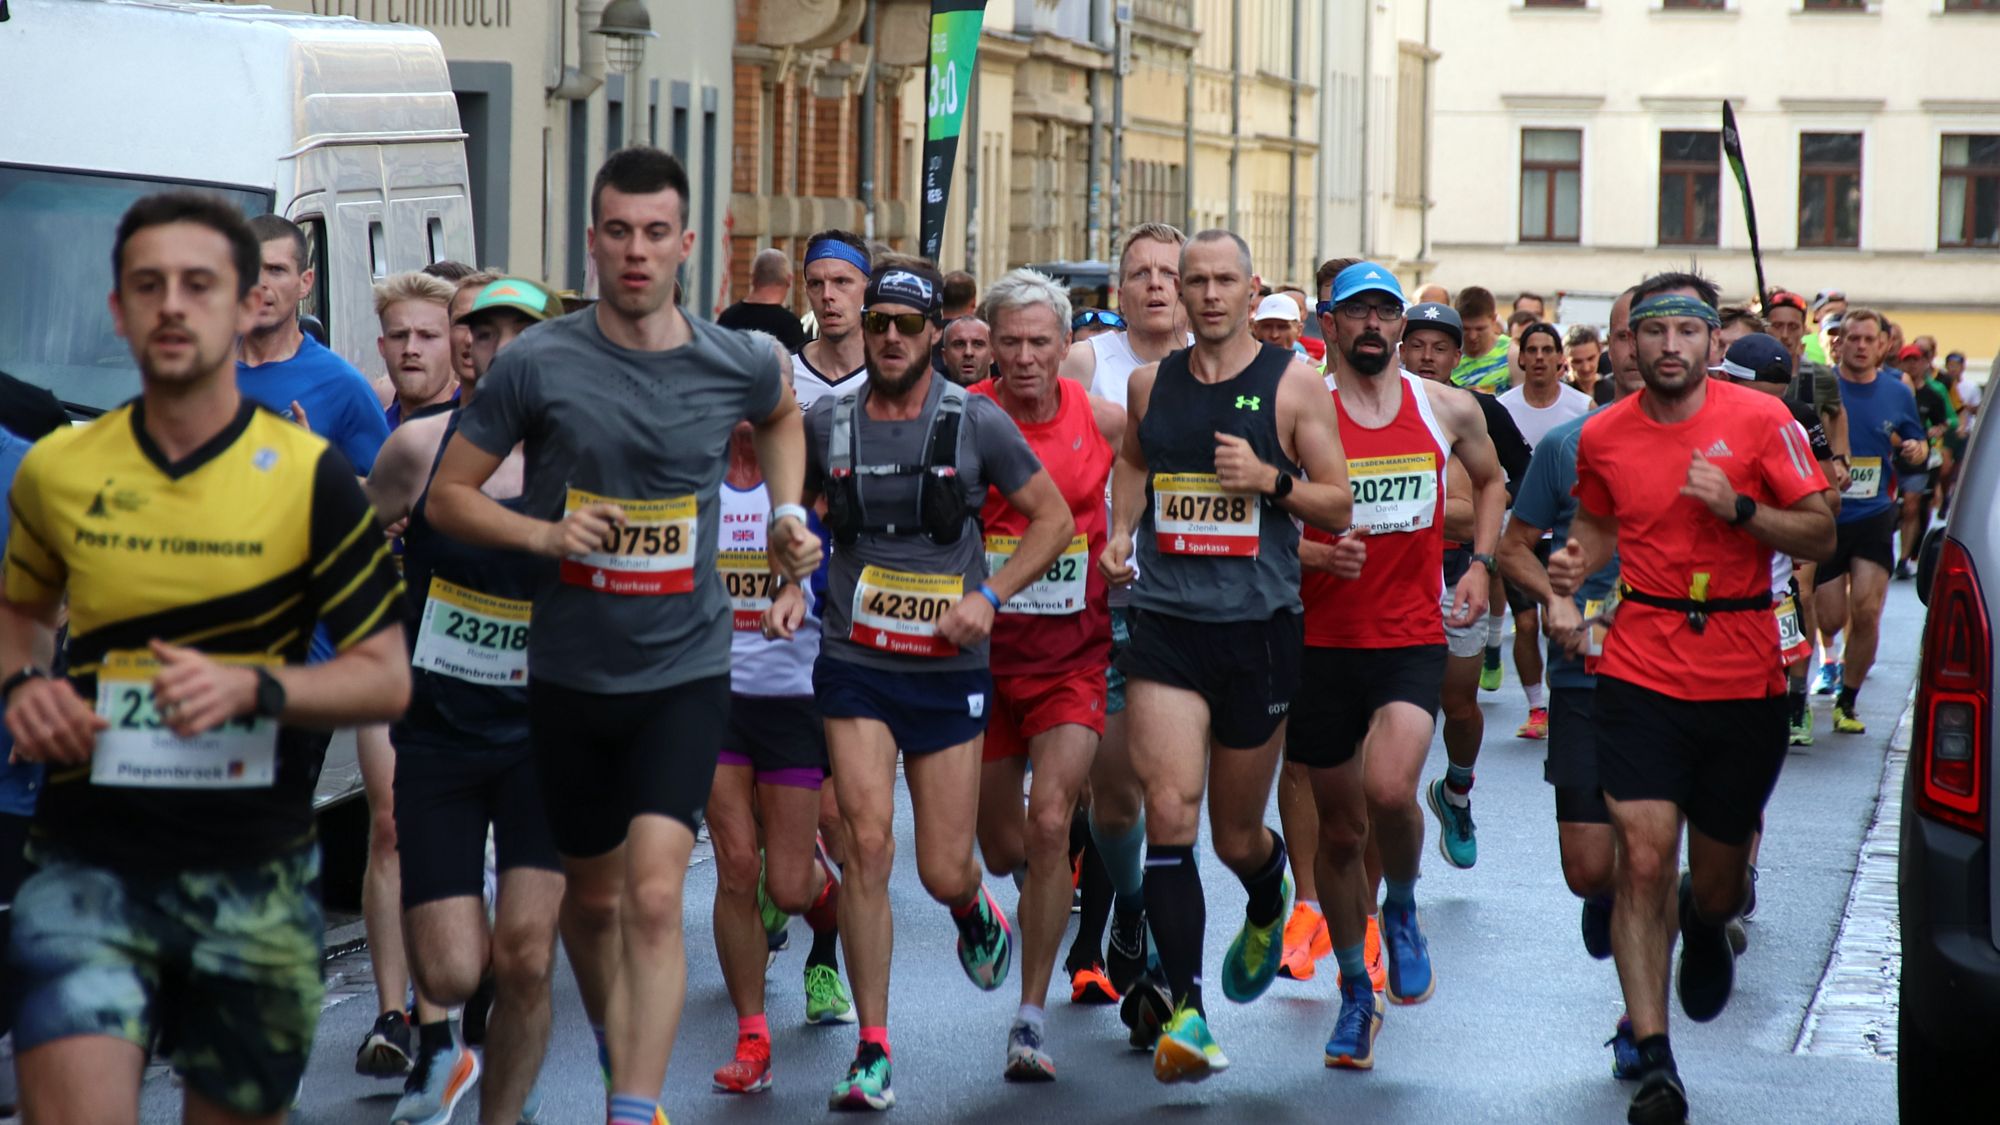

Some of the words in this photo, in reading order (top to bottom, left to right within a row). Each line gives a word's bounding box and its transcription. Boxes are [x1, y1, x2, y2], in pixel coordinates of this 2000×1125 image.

[1851, 468, 1875, 481] 069
[1350, 475, 1422, 504] 20277
[723, 513, 762, 523] SUE
[1166, 495, 1246, 522] 40788
[1375, 504, 1398, 513] David
[159, 536, 264, 557] TÜBINGEN
[602, 524, 680, 555] 0758
[1188, 542, 1230, 554] Sparkasse
[609, 579, 661, 592] Sparkasse
[726, 572, 771, 597] 037
[868, 592, 950, 622] 42300
[445, 610, 529, 651] 23218
[890, 639, 932, 653] Sparkasse
[434, 657, 507, 681] Piepenbrock
